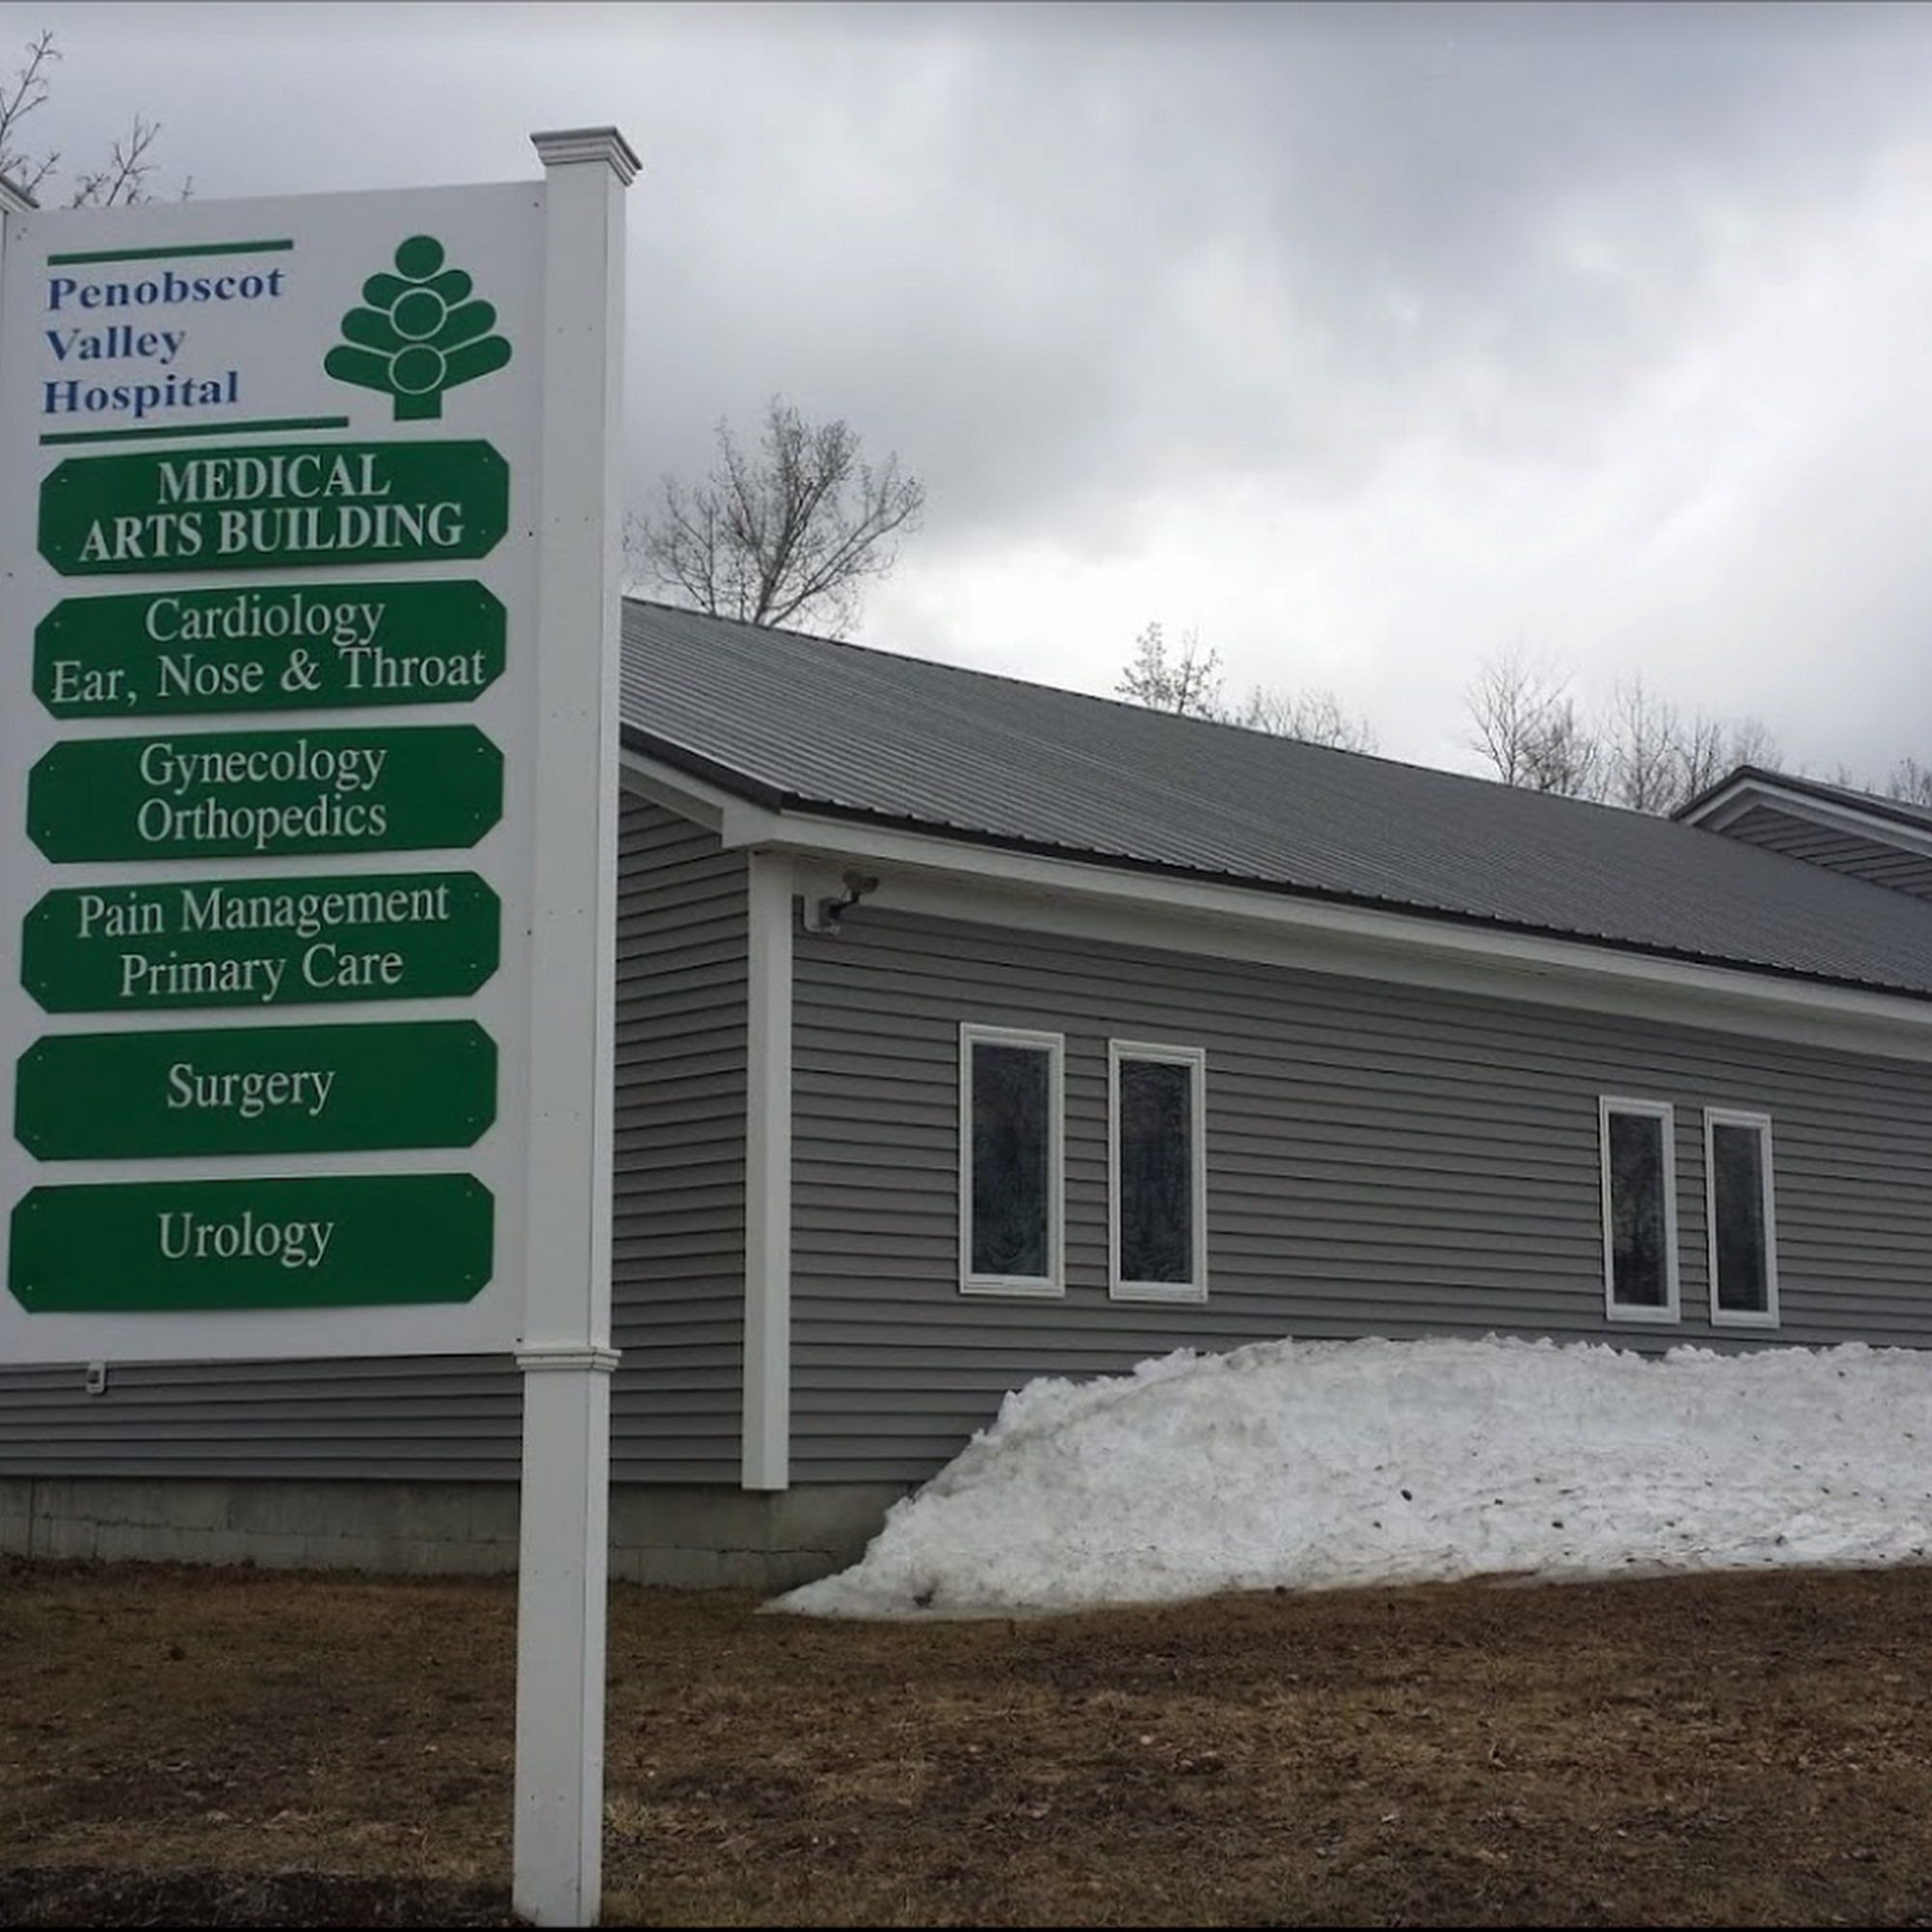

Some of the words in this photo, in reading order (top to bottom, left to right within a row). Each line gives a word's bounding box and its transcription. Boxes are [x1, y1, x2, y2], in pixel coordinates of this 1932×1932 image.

[48, 267, 284, 311] Penobscot
[46, 326, 185, 365] Valley
[43, 371, 239, 417] Hospital
[156, 453, 391, 505] MEDICAL
[79, 512, 202, 562] ARTS
[216, 501, 464, 554] BUILDING
[145, 592, 385, 645] Cardiology
[51, 661, 136, 705] Ear,
[157, 654, 264, 697] Nose
[281, 648, 321, 692] &
[338, 644, 486, 691] Throat
[140, 739, 386, 795] Gynecology
[138, 794, 387, 850] Orthopedics
[77, 891, 164, 939] Pain
[179, 880, 450, 938] Management
[120, 951, 286, 1002] Primary
[302, 943, 404, 988] Care
[167, 1063, 335, 1118] Surgery
[158, 1210, 335, 1268] Urology
